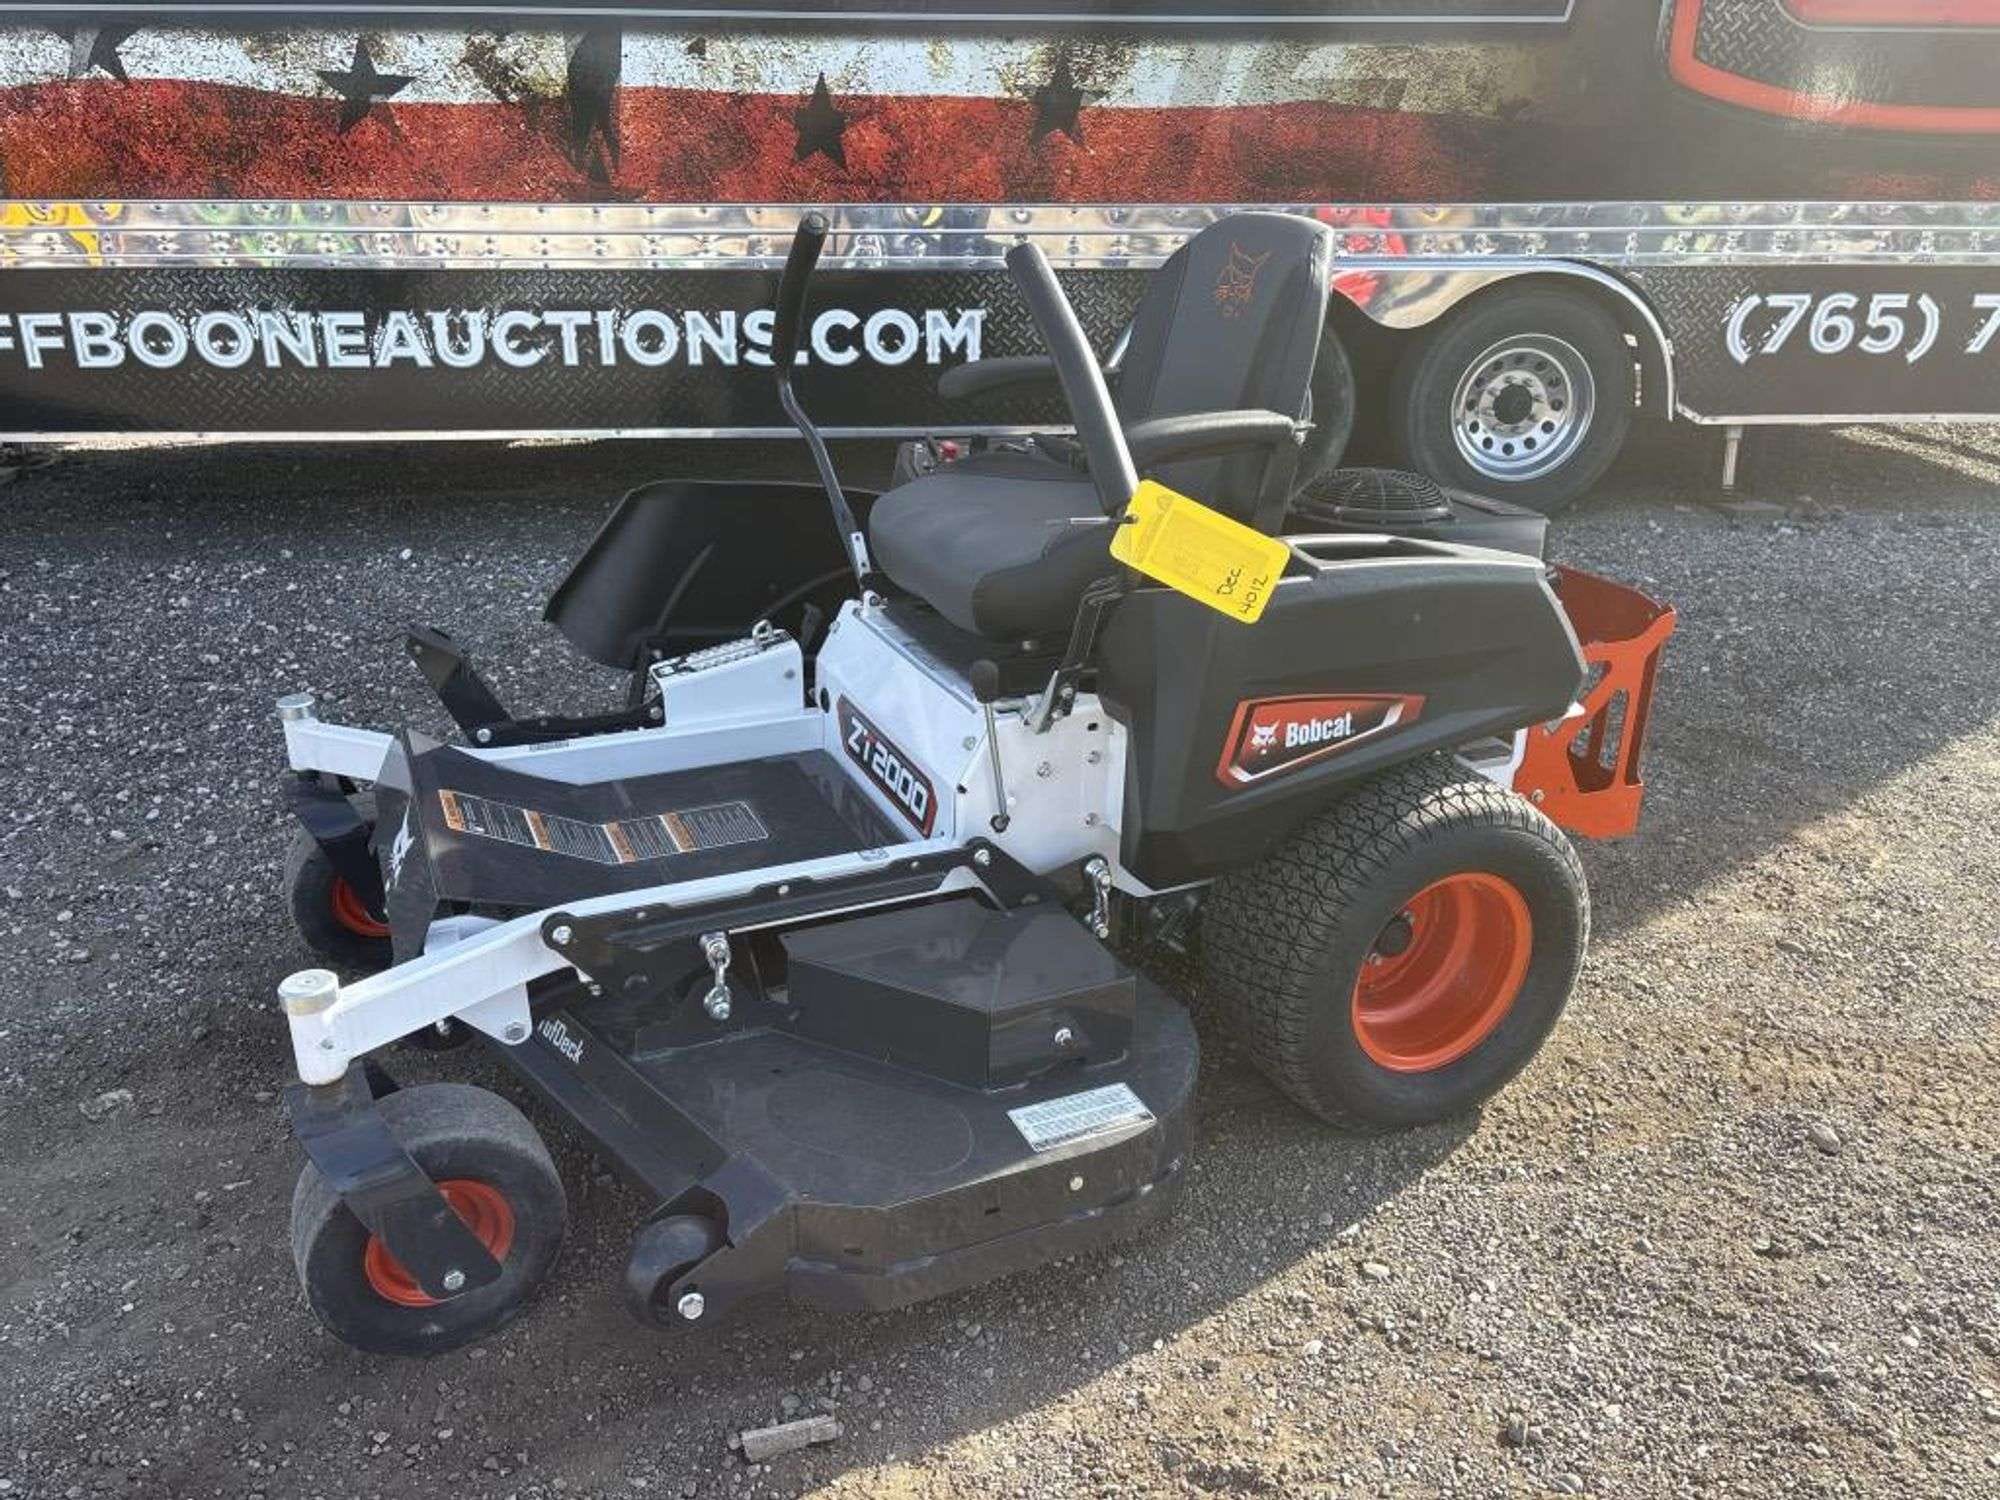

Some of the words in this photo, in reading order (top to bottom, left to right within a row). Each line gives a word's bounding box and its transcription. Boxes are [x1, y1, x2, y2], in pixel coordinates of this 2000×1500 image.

[1726, 293, 1940, 365] (765)
[1217, 566, 1243, 596] Dec
[1238, 574, 1269, 615] 4012
[1285, 710, 1353, 748] Bobcat
[846, 715, 929, 823] ZT2000
